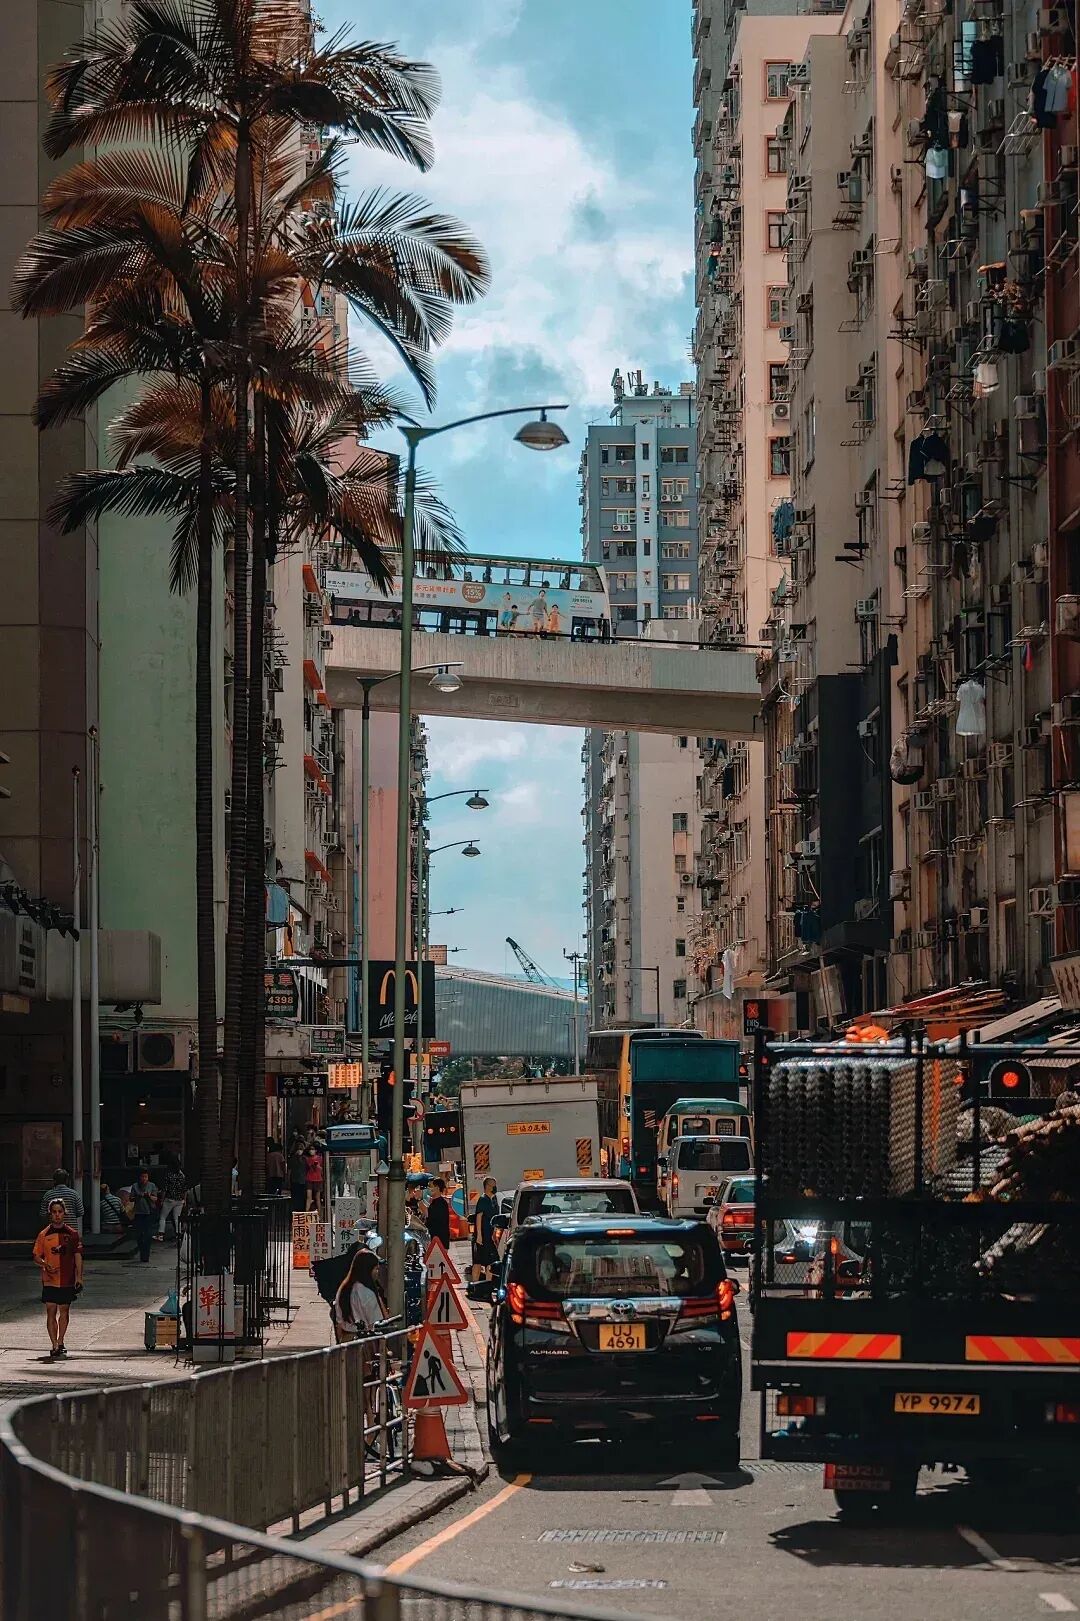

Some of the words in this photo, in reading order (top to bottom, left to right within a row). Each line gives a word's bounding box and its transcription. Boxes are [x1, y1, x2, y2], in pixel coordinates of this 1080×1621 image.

[466, 588, 482, 597] 15%
[612, 1324, 632, 1337] UJ
[606, 1336, 640, 1348] 4691
[899, 1394, 922, 1410] YP
[928, 1396, 976, 1411] 9974
